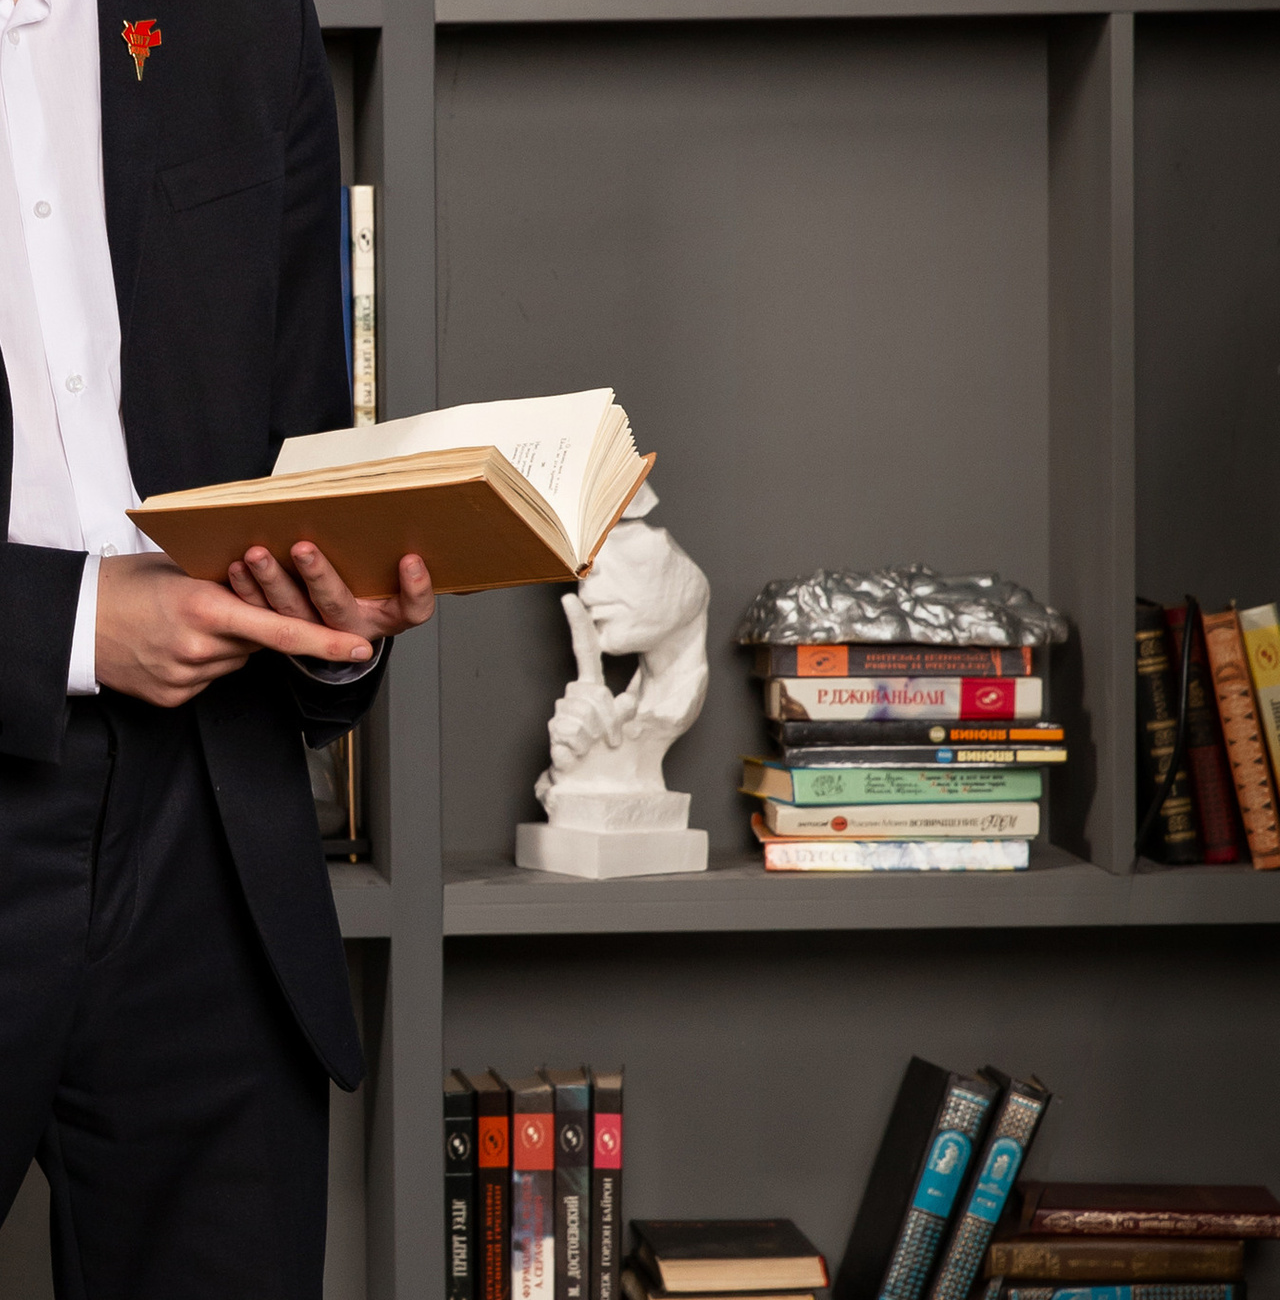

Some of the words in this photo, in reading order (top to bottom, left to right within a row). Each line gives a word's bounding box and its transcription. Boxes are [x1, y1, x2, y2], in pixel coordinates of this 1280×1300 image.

[829, 687, 945, 706] ДЖОВАНЬОЛИ
[950, 729, 1006, 740] ЯПОНИЯ
[956, 749, 1014, 762] ЯПОНИЯ
[452, 1198, 466, 1230] УЭЛЛС
[599, 1177, 612, 1221] БАЙРОН
[563, 1195, 580, 1278] ДОСТОЕВСКИЙ
[601, 1225, 612, 1266] ГОРДОН
[452, 1235, 467, 1276] ГЕРБЕРТ
[521, 1237, 531, 1297] ФУРМАНОВ
[568, 1284, 580, 1297] М.
